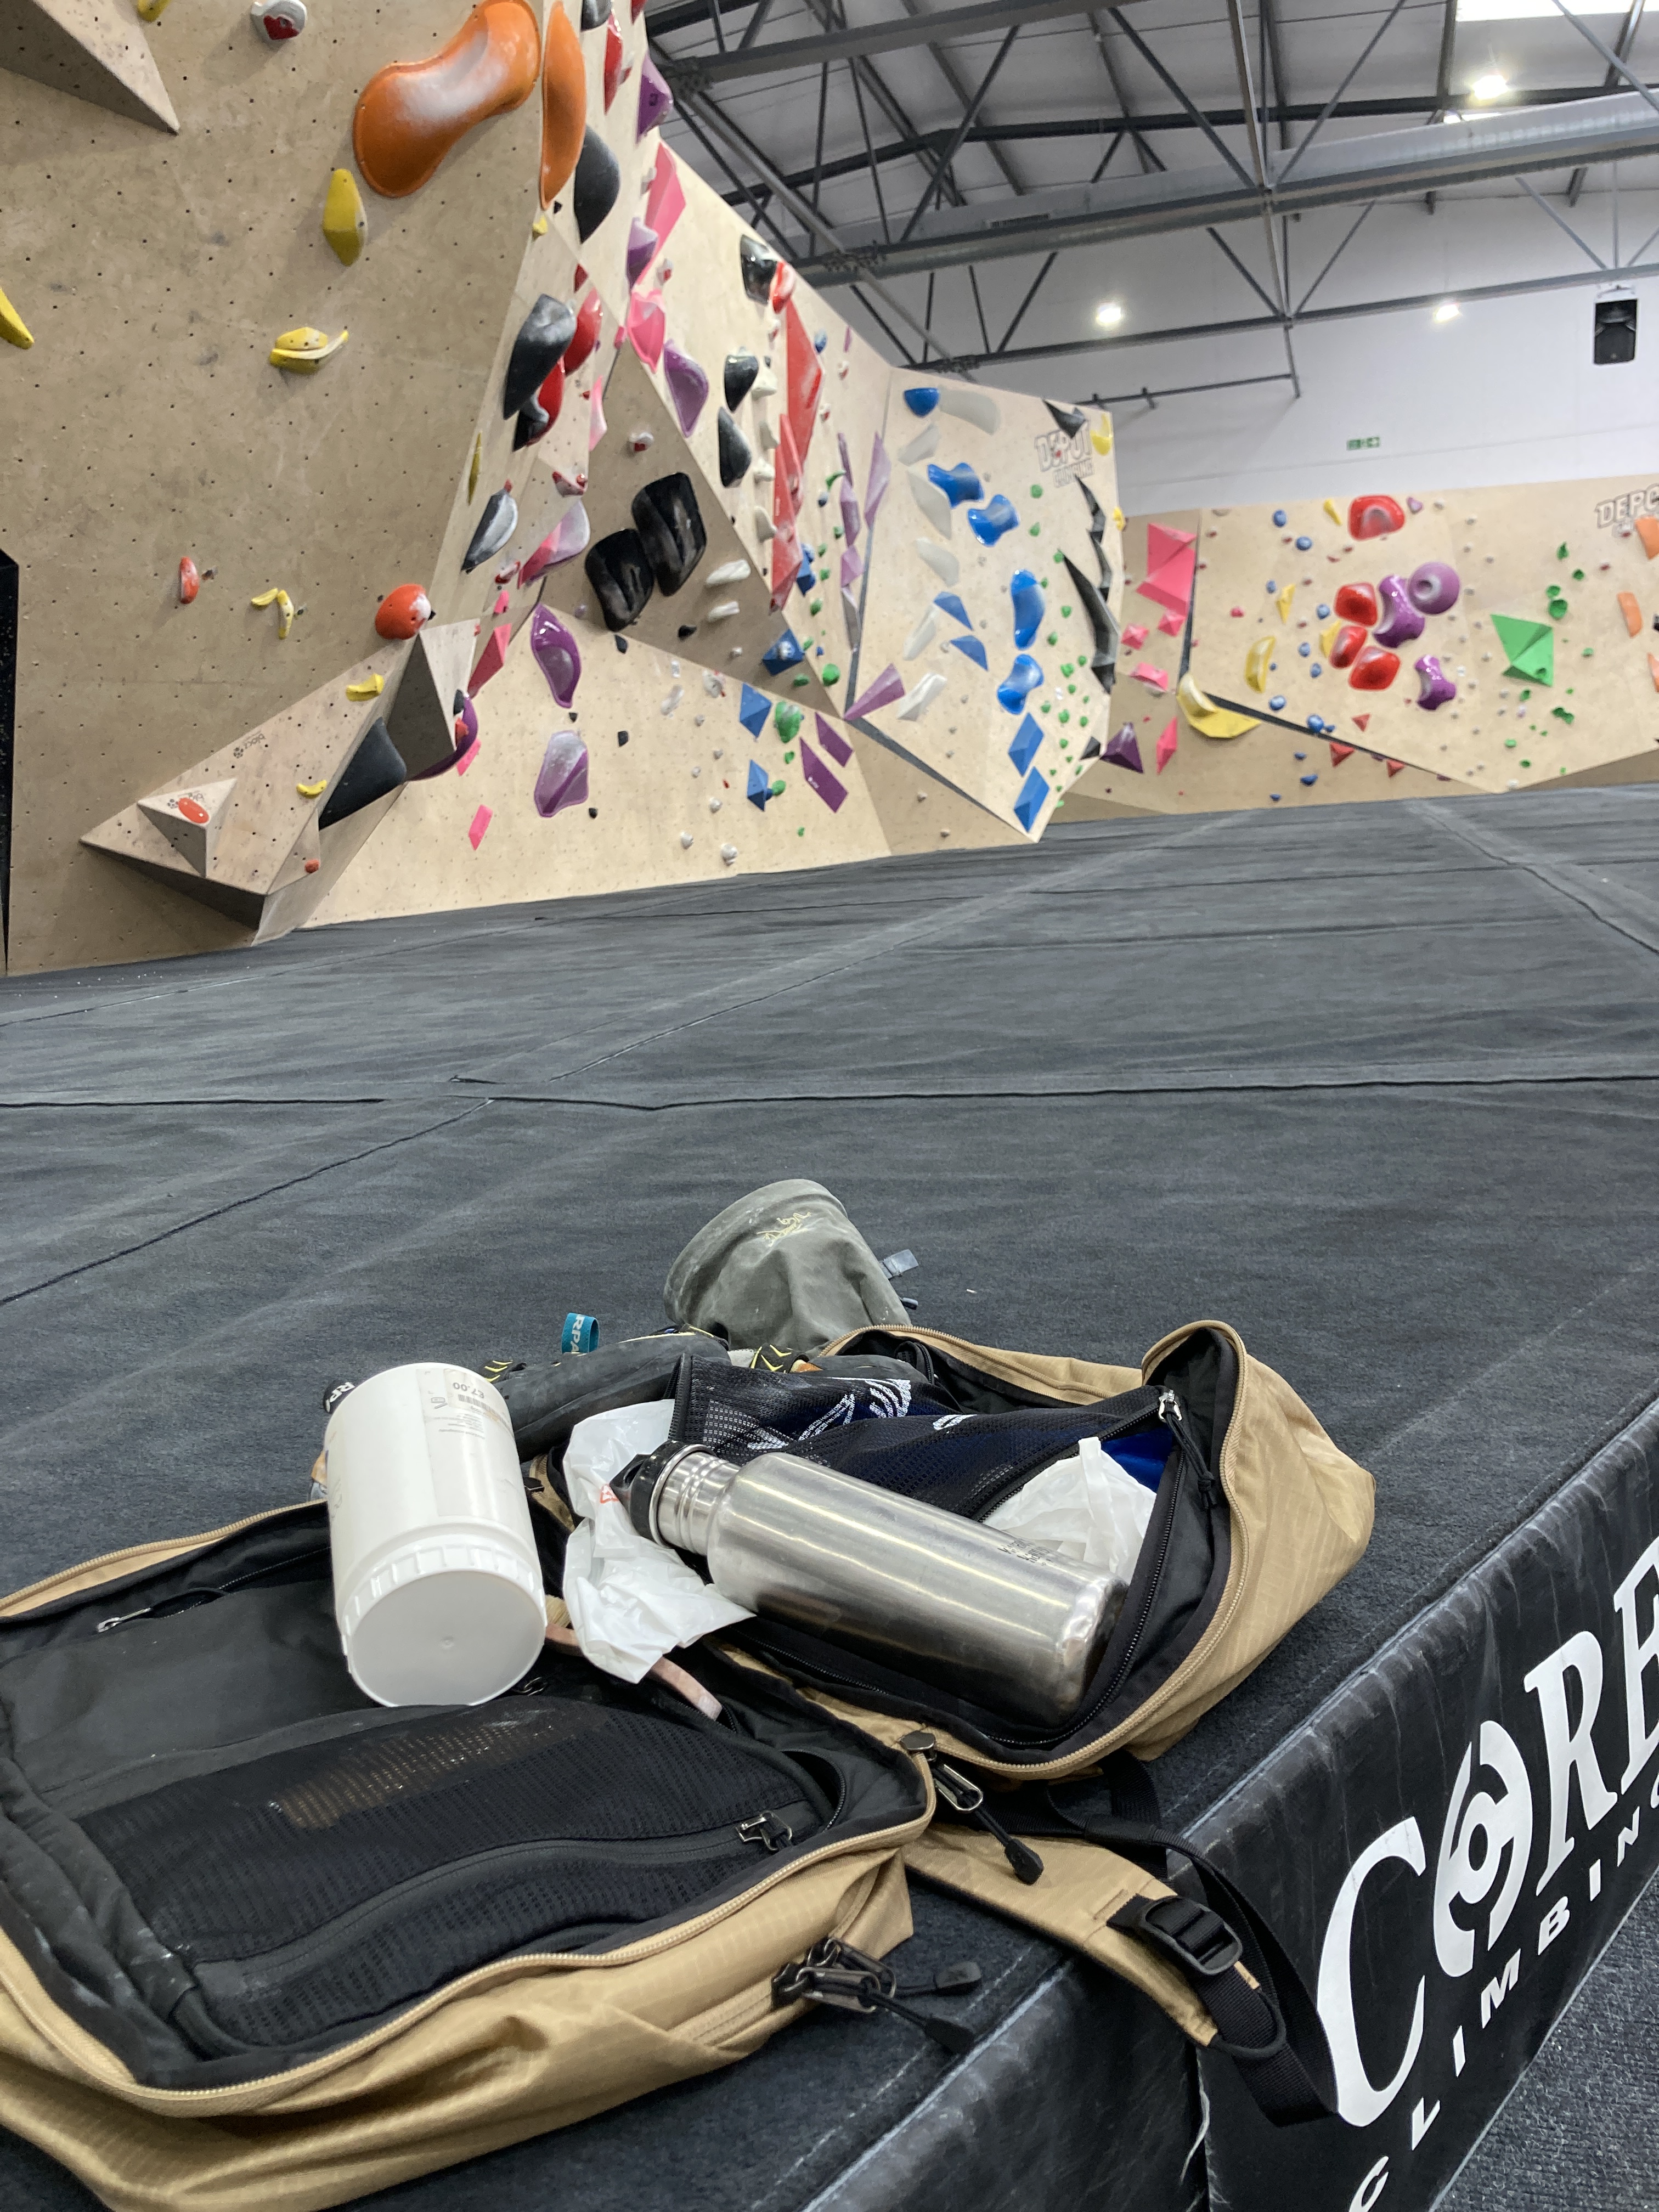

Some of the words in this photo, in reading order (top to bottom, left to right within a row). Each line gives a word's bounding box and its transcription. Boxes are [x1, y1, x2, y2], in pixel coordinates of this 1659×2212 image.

[571, 1314, 585, 1354] RPA
[453, 1382, 485, 1399] £7.00
[1348, 1772, 1659, 2212] CLIMBIN
